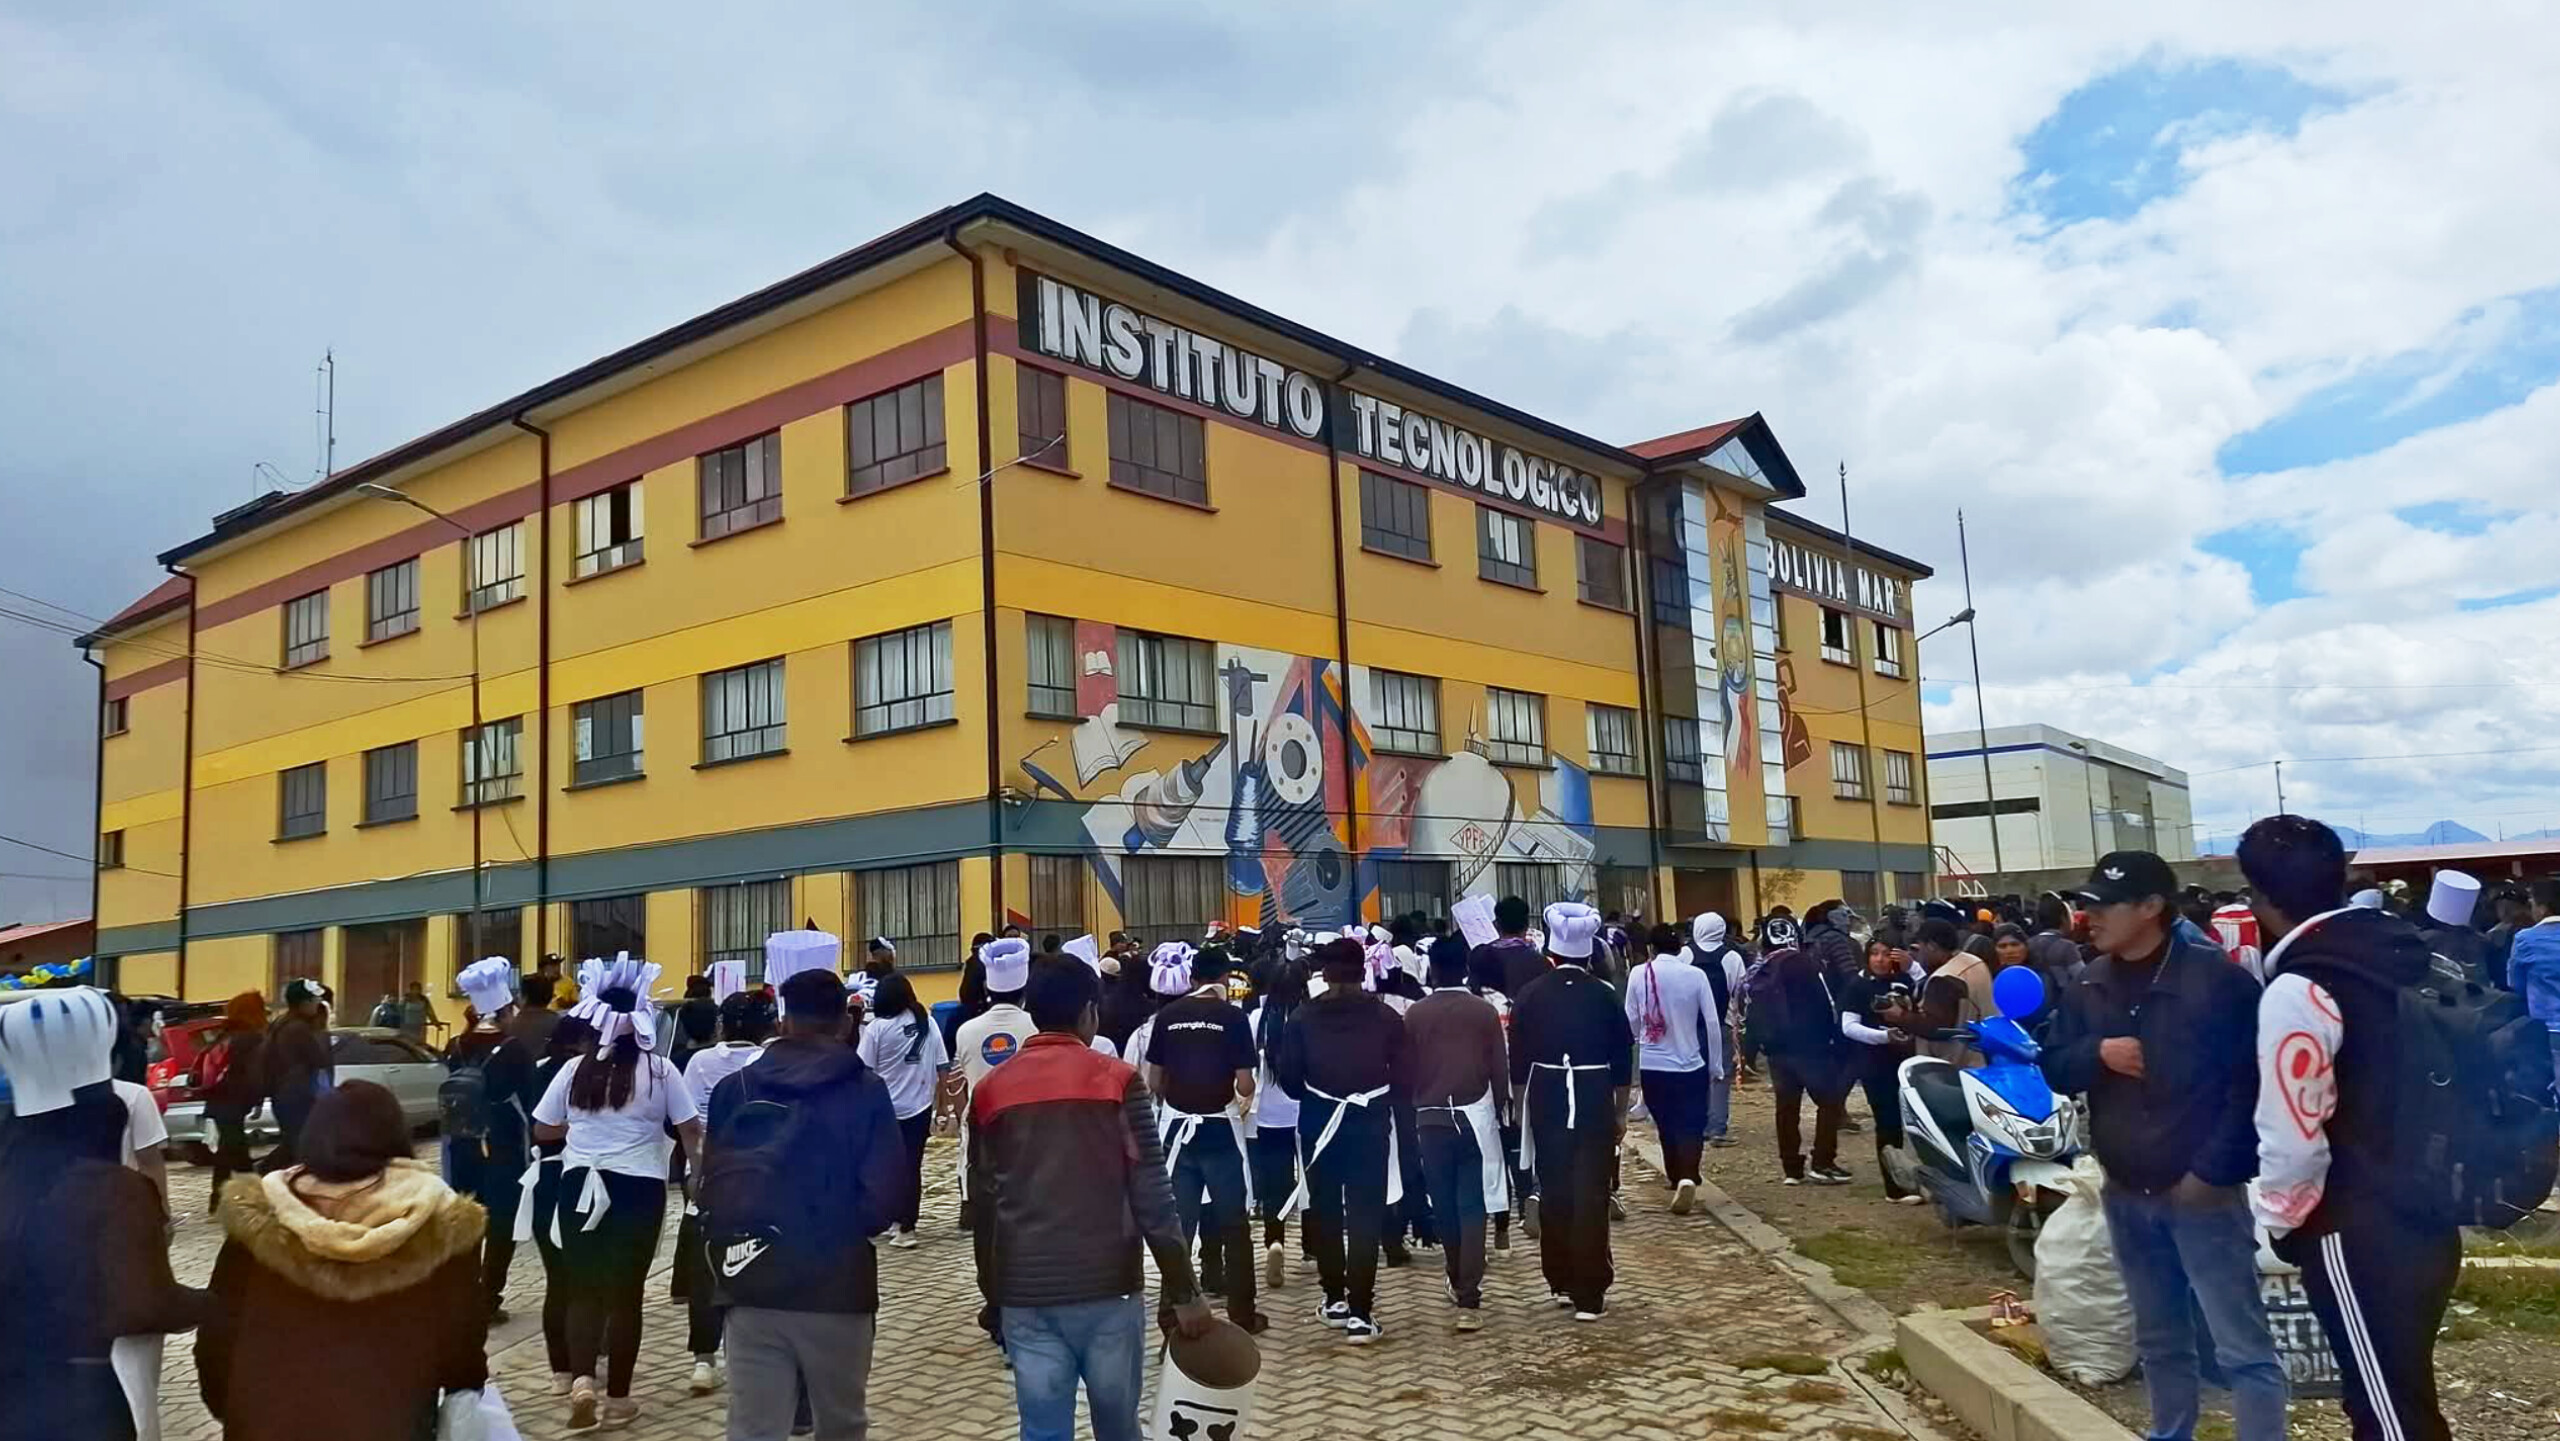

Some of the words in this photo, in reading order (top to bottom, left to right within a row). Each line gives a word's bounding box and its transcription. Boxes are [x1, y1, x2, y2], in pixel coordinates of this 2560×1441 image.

[1038, 276, 1323, 438] INSTITUTO
[1766, 537, 1847, 604] BOLIVIA
[726, 1238, 757, 1264] NIKE
